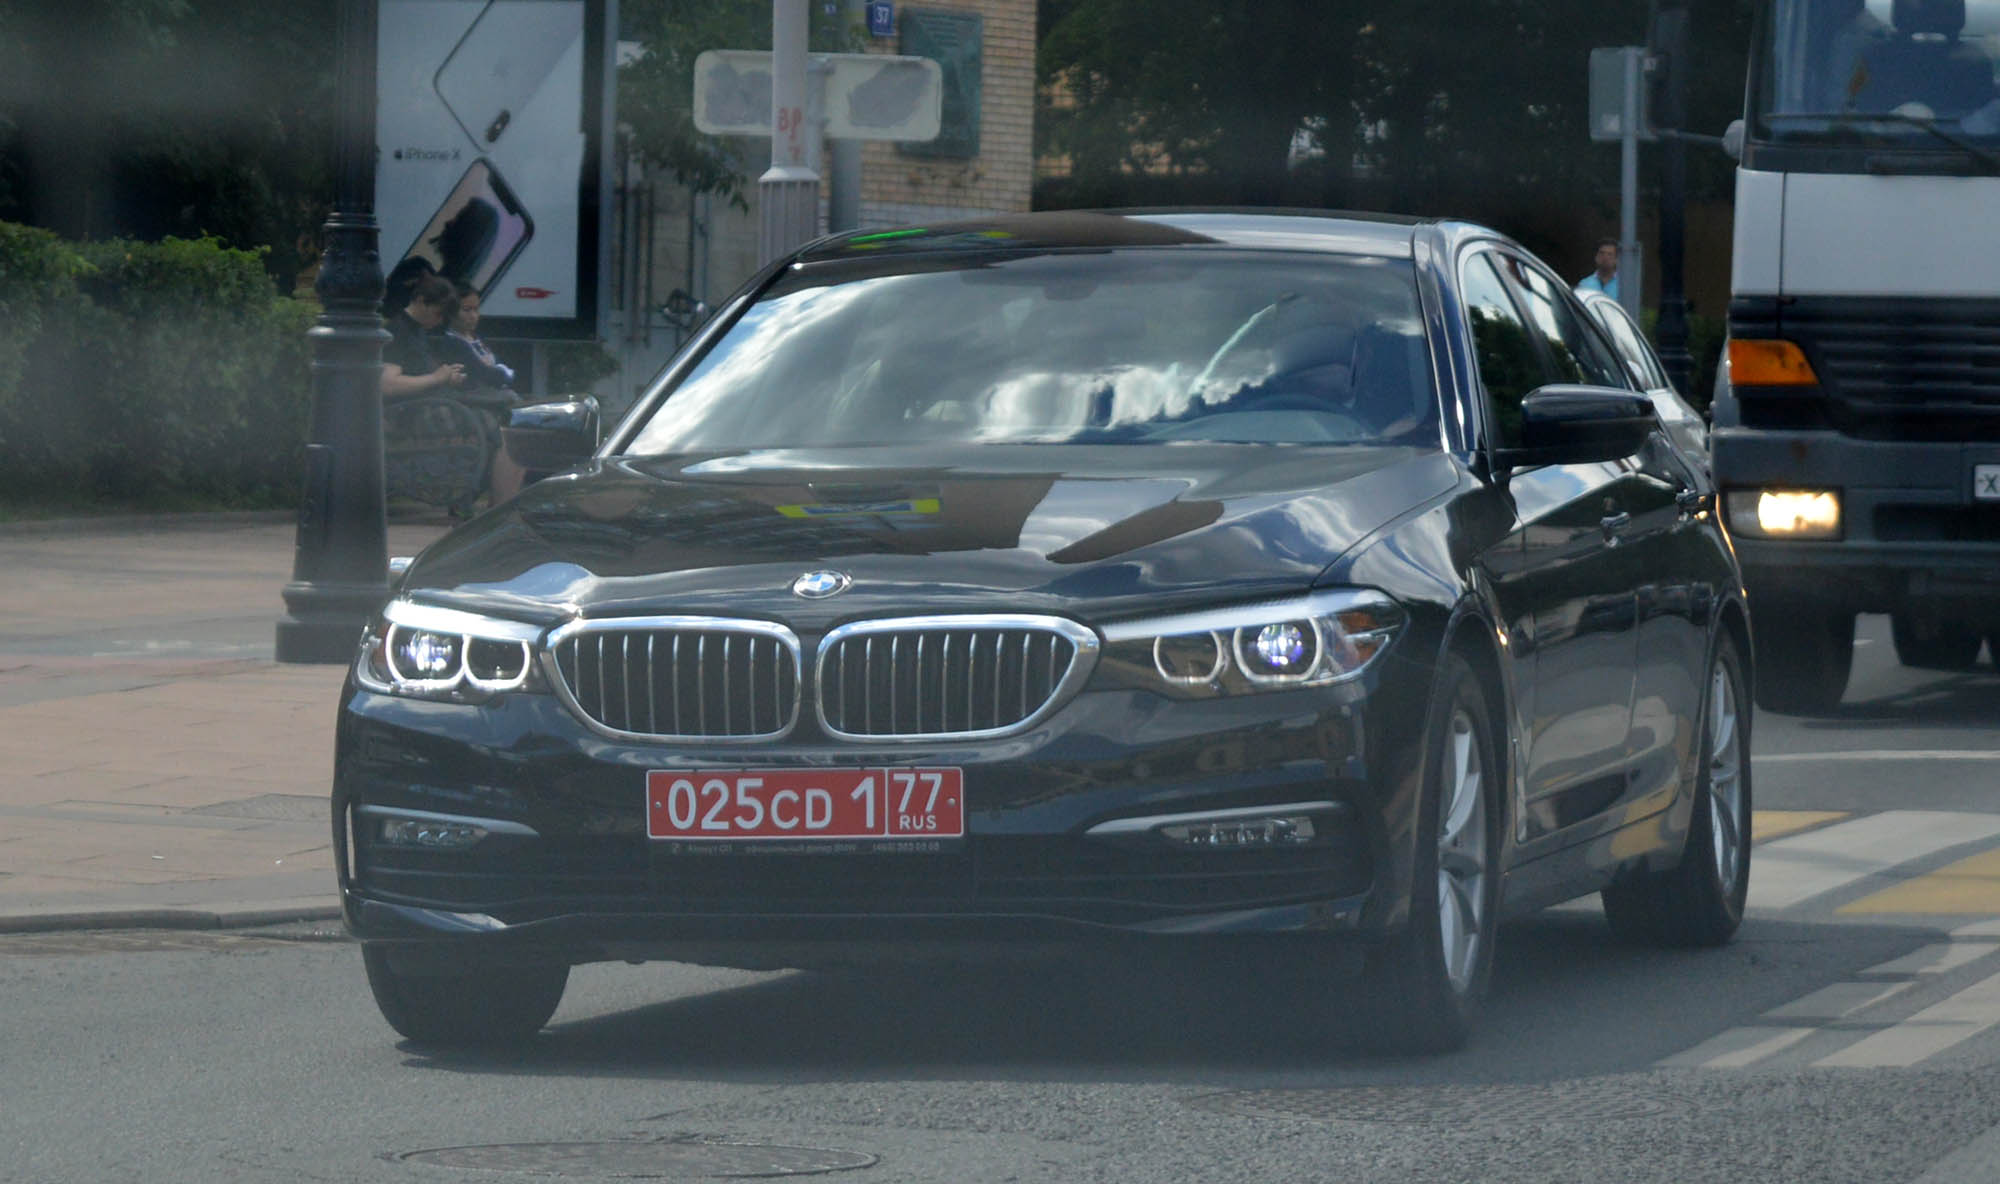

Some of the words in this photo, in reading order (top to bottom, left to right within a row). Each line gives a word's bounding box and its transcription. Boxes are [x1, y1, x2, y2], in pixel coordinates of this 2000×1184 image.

[875, 6, 889, 24] 37
[404, 147, 449, 160] iPhone
[893, 773, 942, 813] 77
[899, 815, 937, 830] RUS
